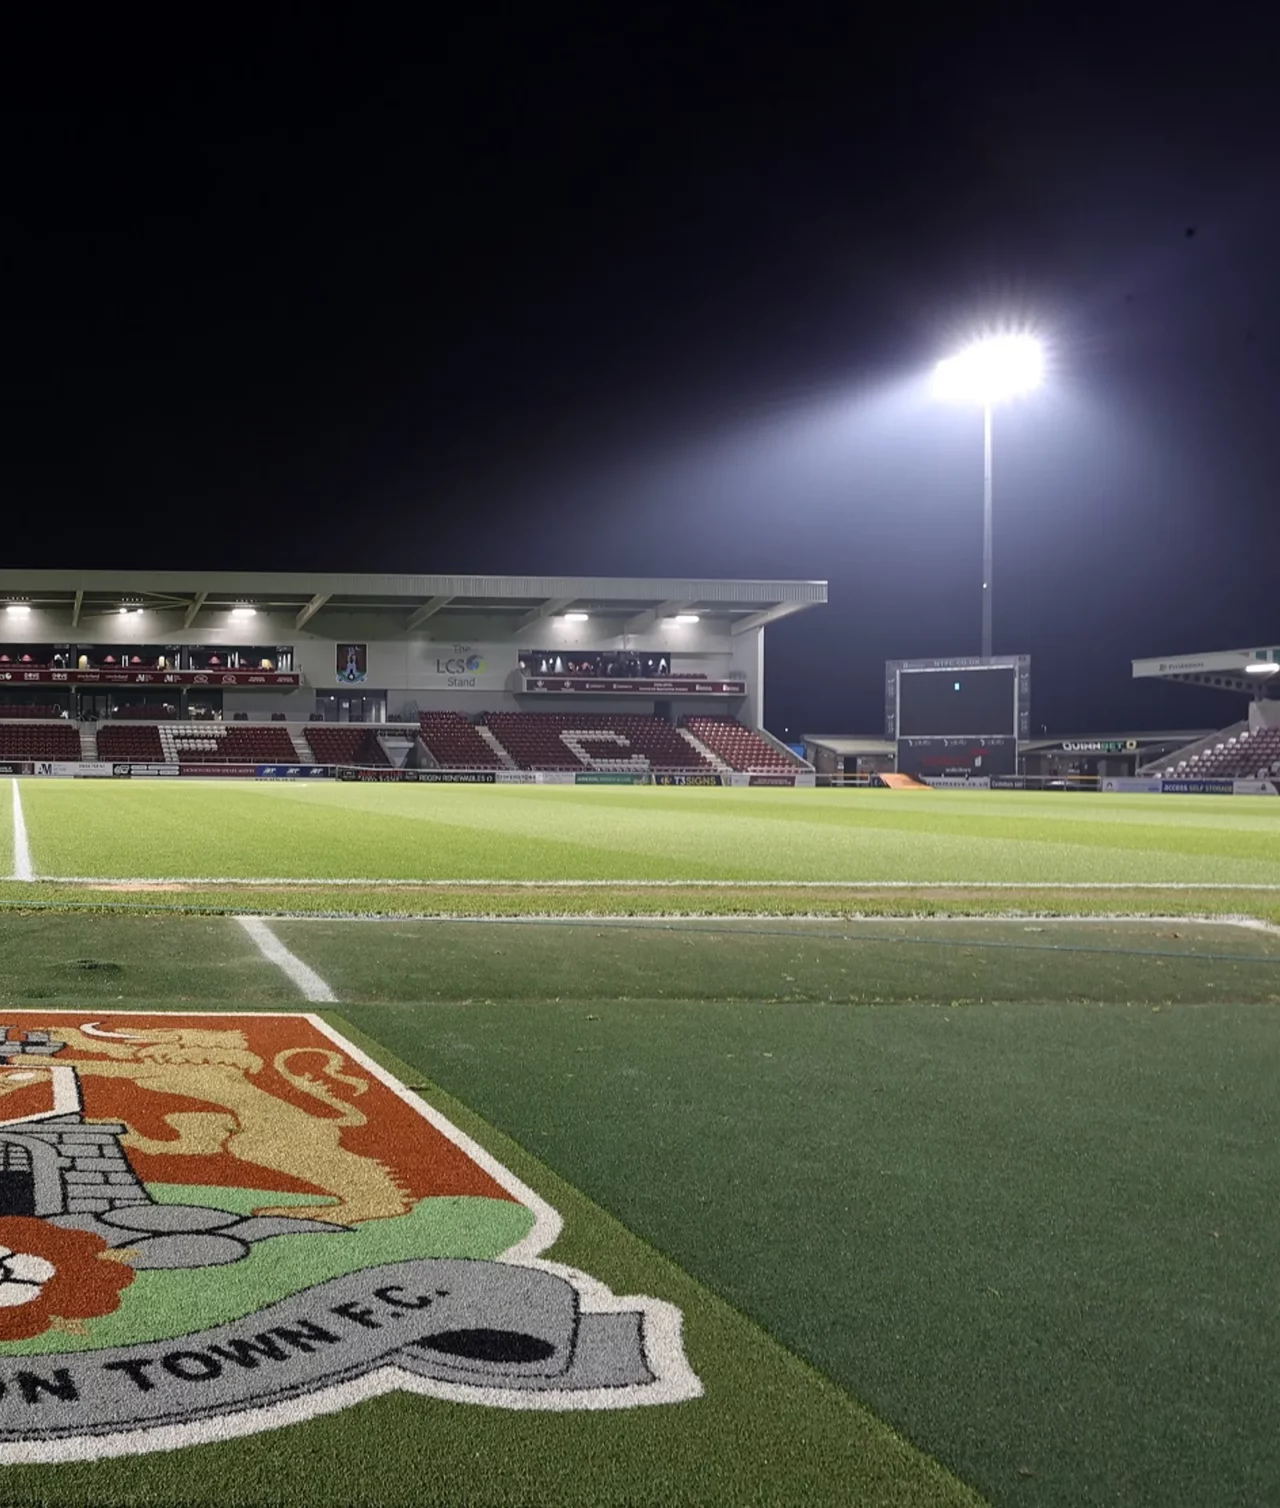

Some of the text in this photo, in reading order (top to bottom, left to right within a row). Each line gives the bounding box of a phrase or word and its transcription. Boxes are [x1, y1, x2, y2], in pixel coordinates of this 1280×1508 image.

[452, 645, 471, 654] The
[436, 660, 465, 675] LCS
[447, 677, 476, 688] Stand
[1062, 742, 1124, 751] QUINNBET
[103, 1319, 341, 1392] TOWN
[332, 1284, 450, 1329] F.C.
